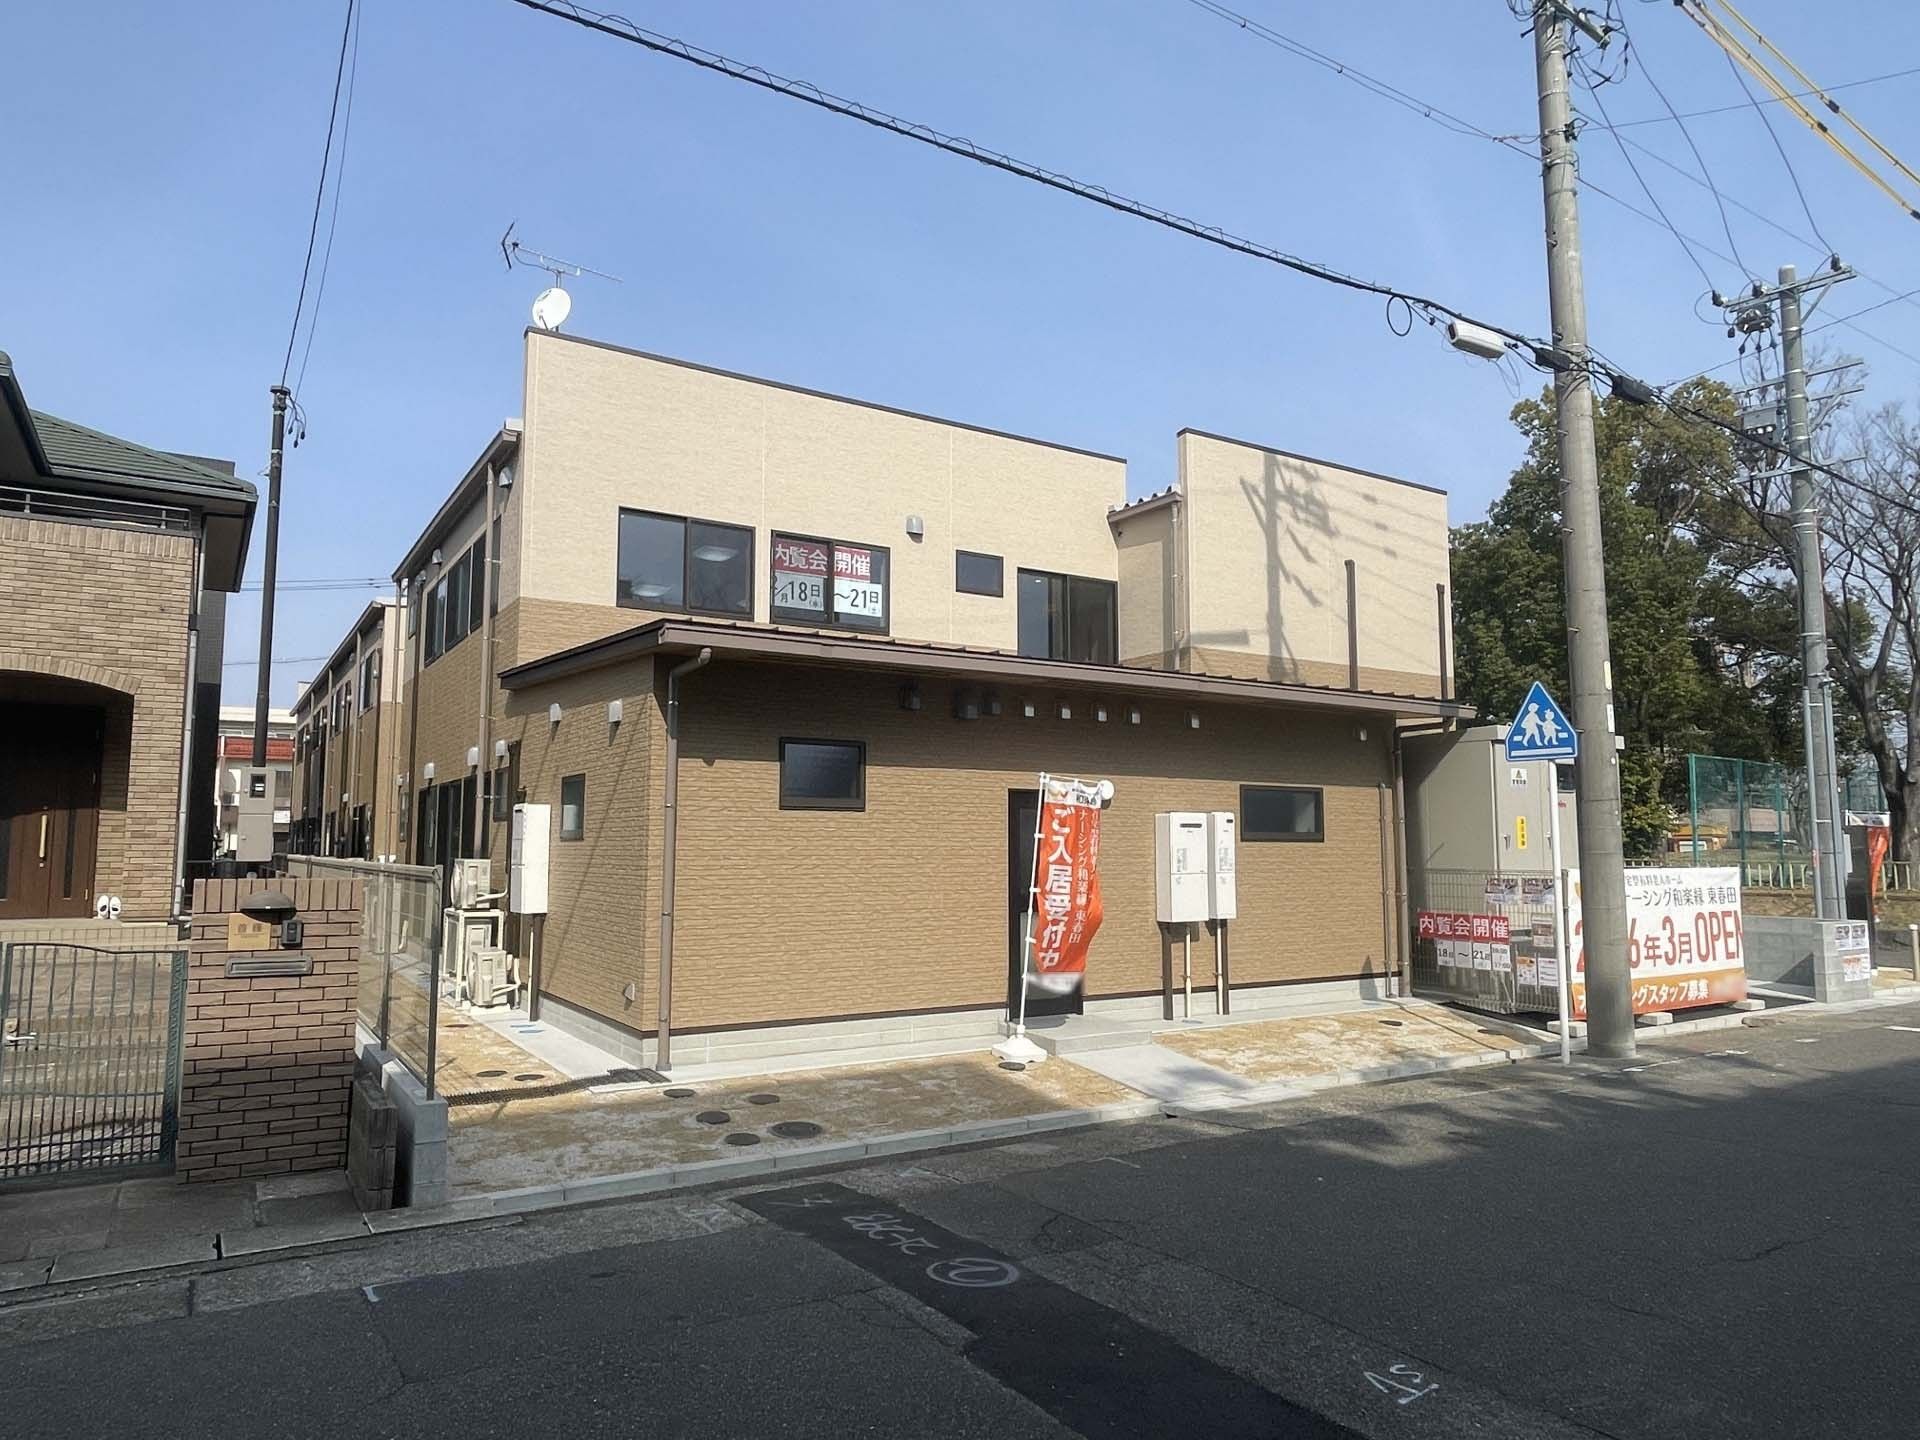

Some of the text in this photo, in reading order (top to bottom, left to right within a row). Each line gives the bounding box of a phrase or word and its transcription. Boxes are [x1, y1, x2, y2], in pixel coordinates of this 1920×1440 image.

[834, 551, 871, 577] 開催
[1626, 873, 1684, 887] 宅型有料老人ホーム
[1419, 915, 1509, 939] 内覧会開催
[1632, 978, 1710, 1008] グスタッフ募集
